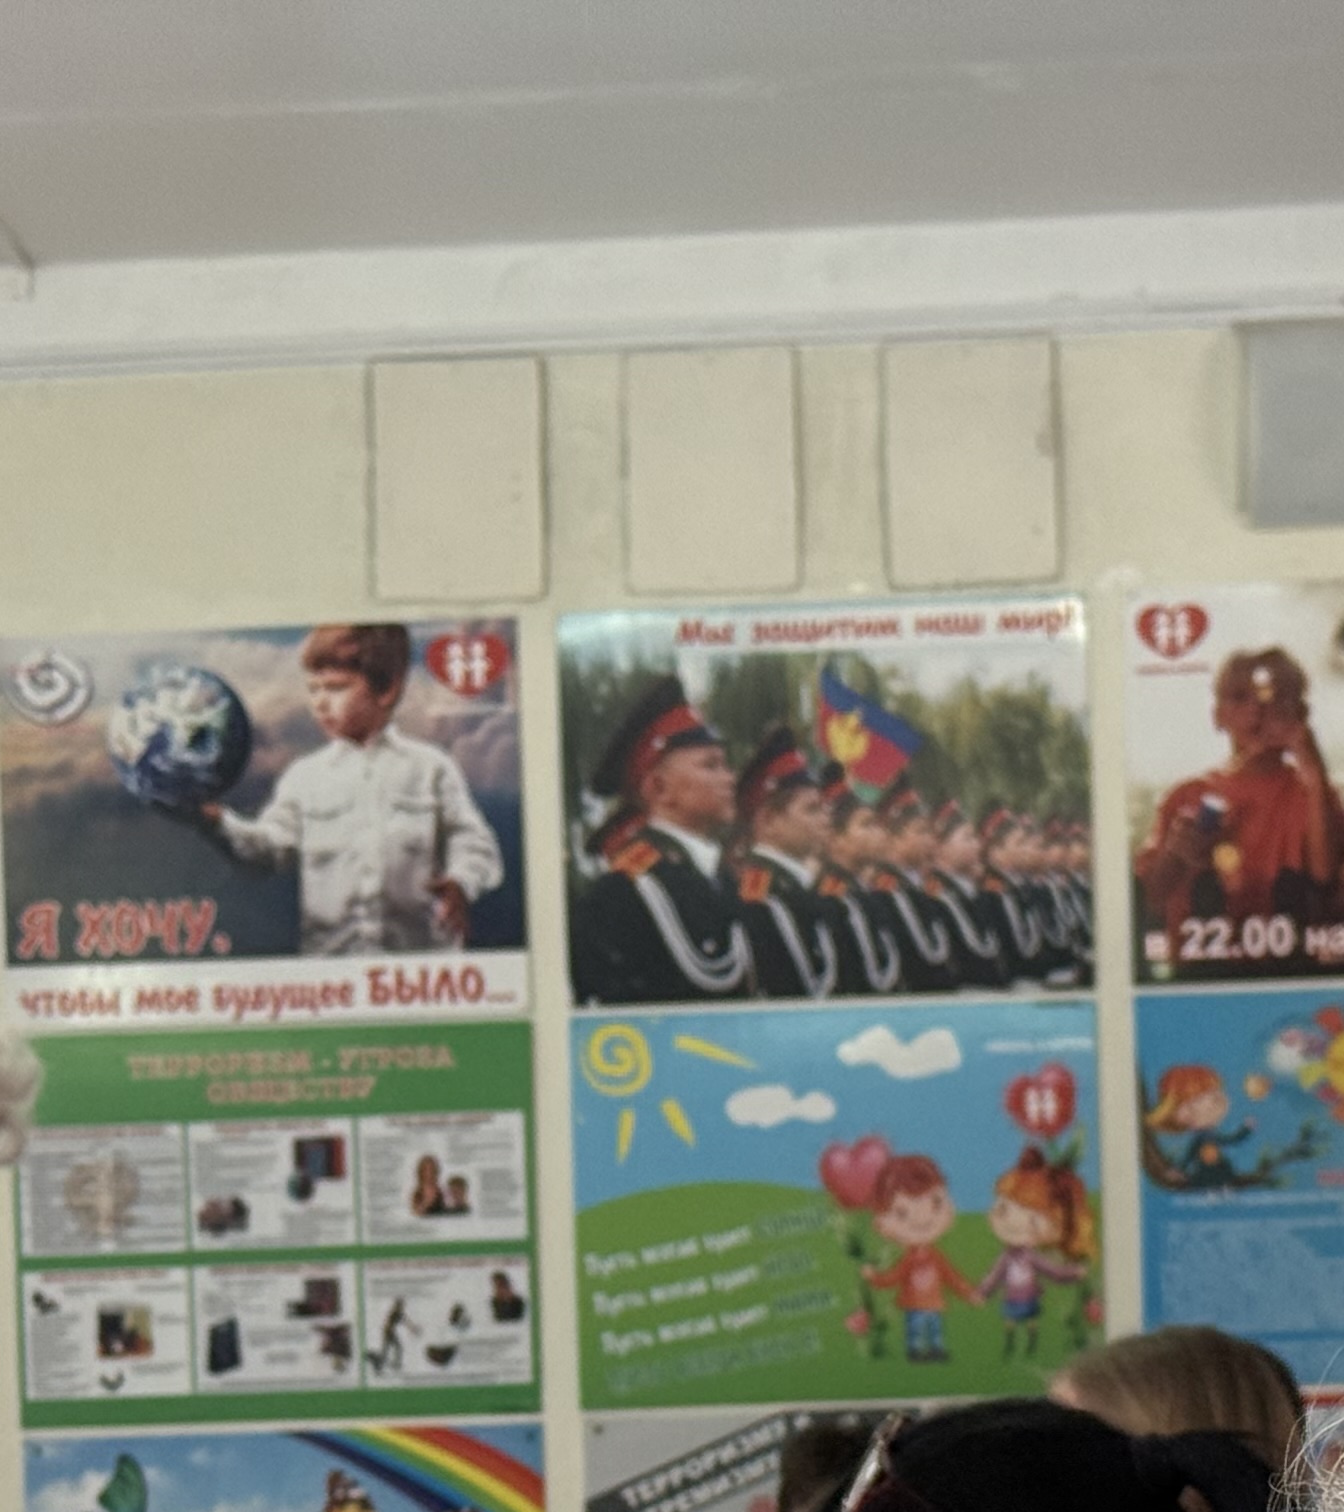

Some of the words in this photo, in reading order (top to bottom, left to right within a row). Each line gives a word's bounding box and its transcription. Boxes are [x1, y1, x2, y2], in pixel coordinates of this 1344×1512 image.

[17, 900, 62, 960] Я
[1179, 914, 1296, 961] 22.00
[18, 989, 121, 1018] чтобы
